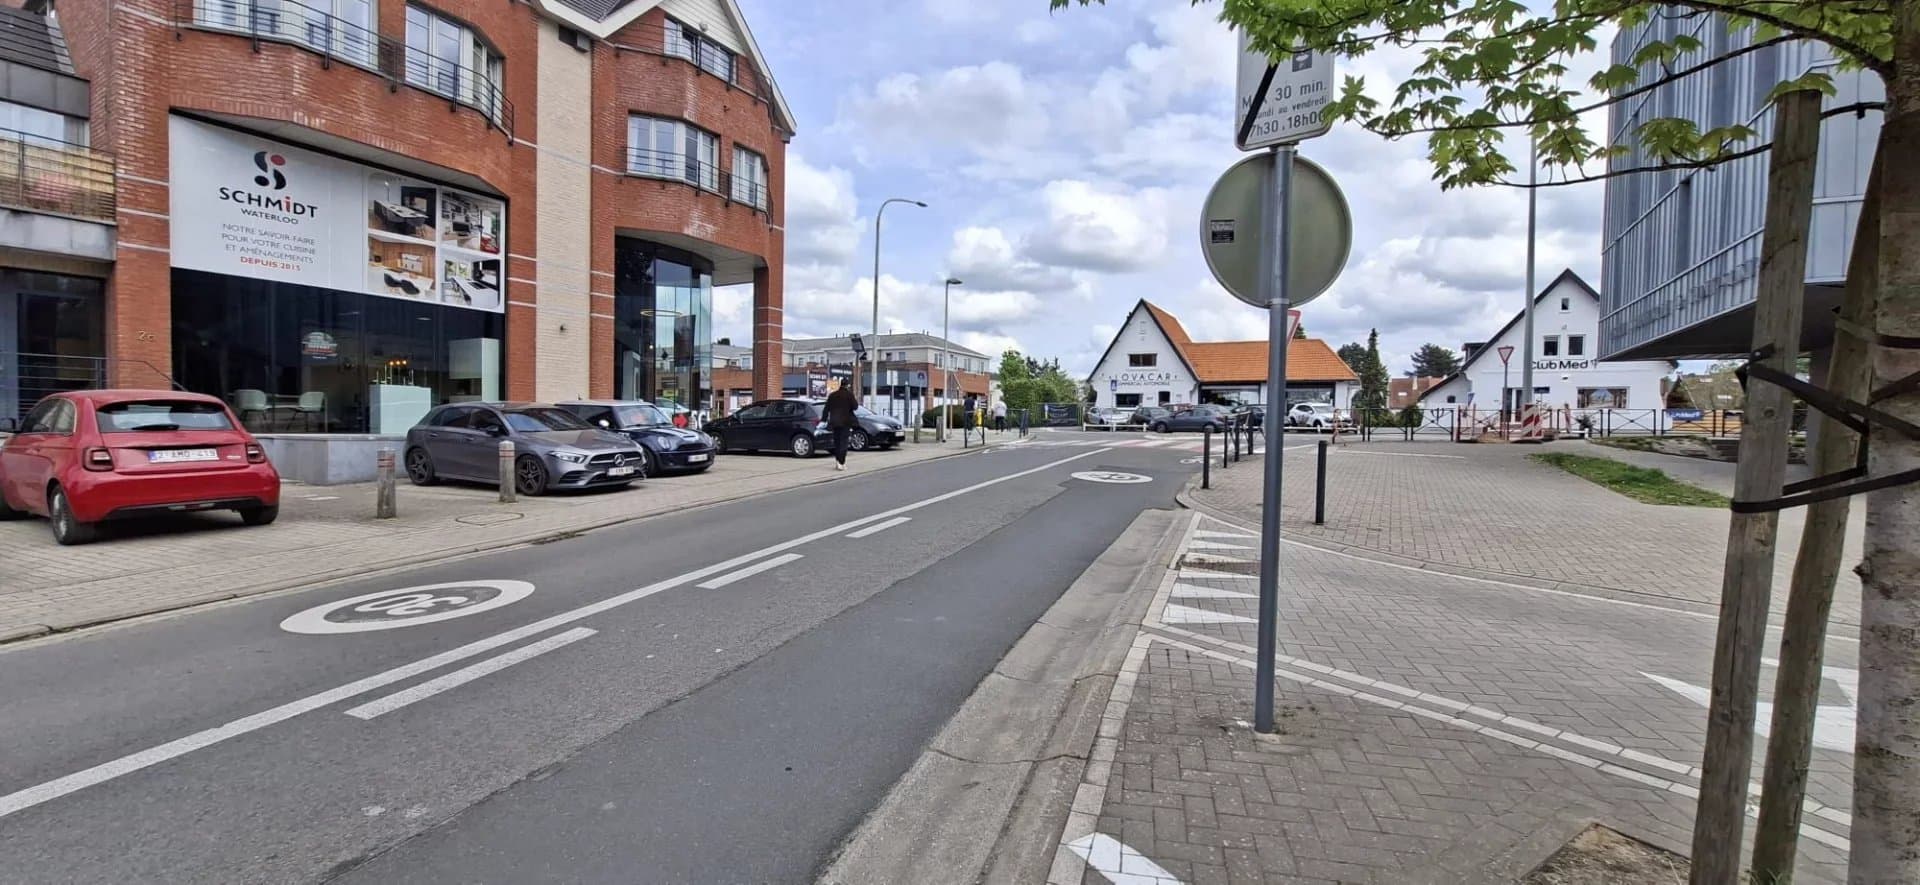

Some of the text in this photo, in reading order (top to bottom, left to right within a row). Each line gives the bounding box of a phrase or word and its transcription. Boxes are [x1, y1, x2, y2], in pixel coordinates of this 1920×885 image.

[1275, 81, 1327, 101] 30 min.
[1292, 95, 1327, 111] vendredi
[240, 208, 299, 225] WATERLOO
[223, 223, 255, 234] NOTRE
[222, 233, 315, 255] POUR VOTRE CUISINE
[225, 244, 236, 252] ET
[240, 256, 301, 271] DEPUIS 2015
[1559, 360, 1588, 370] Med
